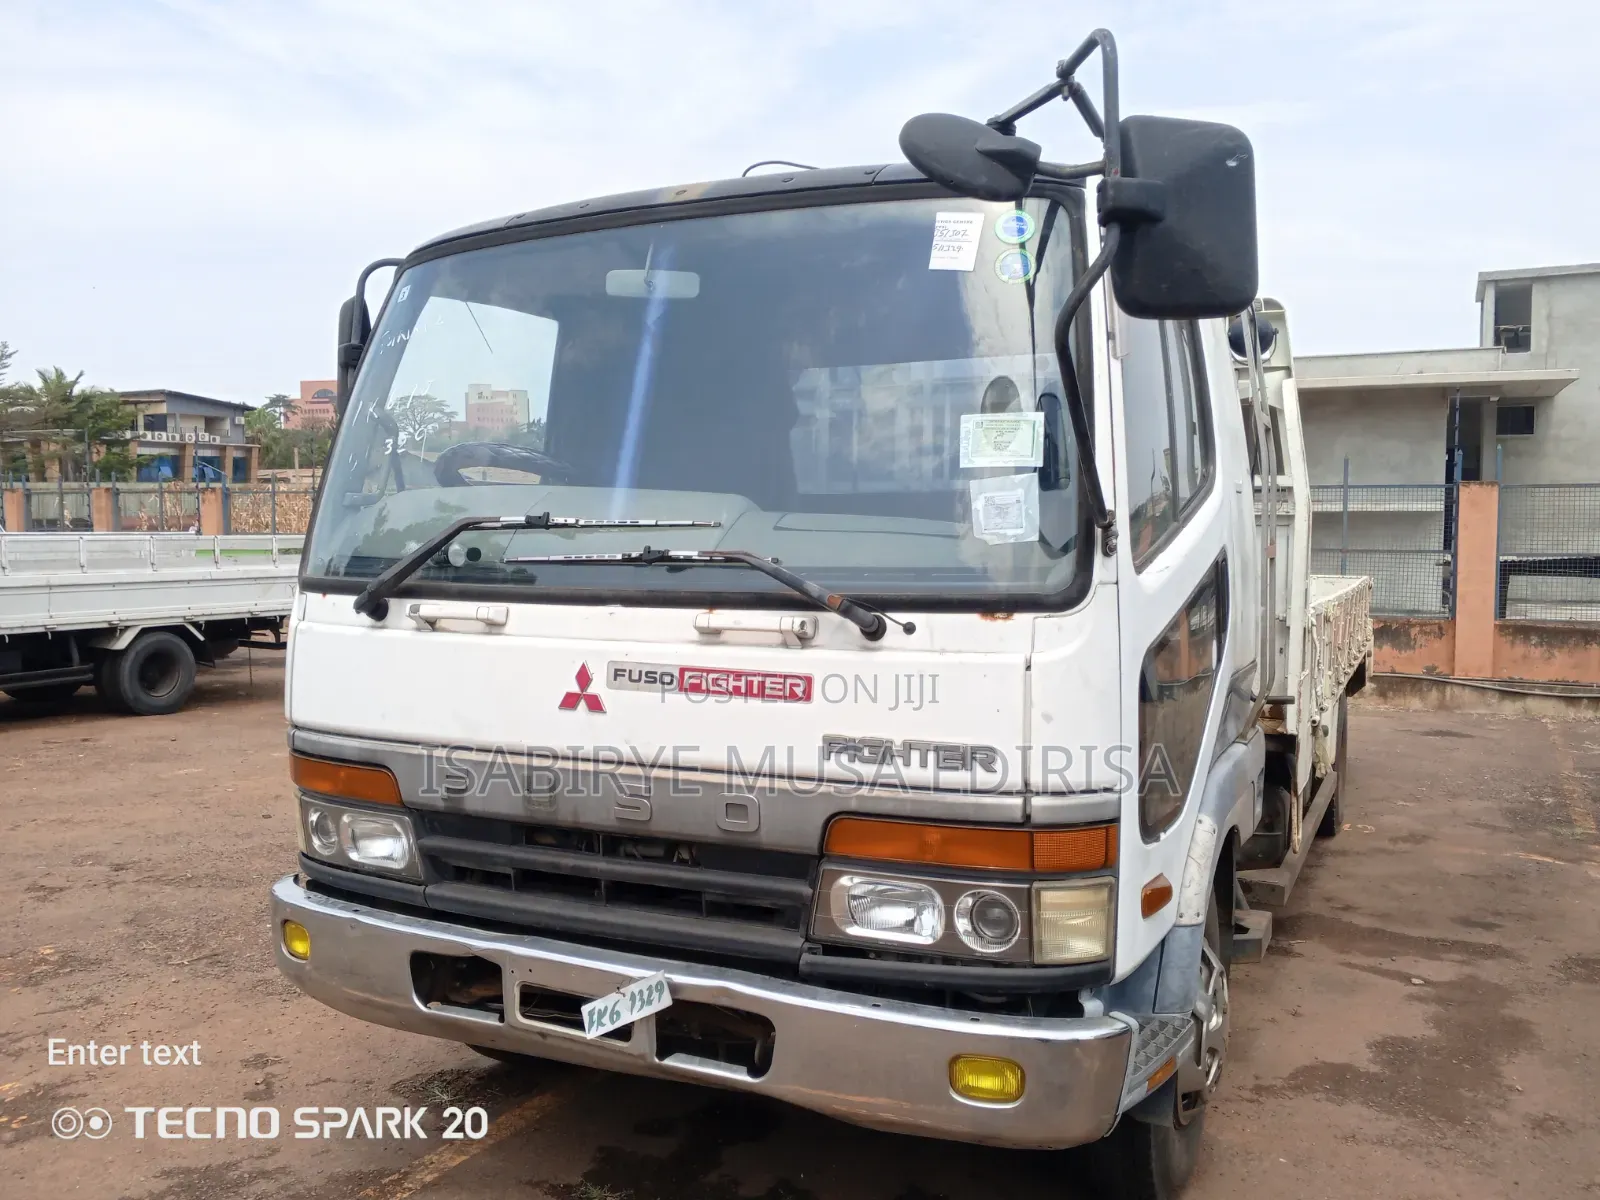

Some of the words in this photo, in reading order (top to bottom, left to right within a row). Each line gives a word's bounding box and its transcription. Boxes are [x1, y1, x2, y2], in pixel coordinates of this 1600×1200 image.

[613, 668, 675, 686] FUSO
[683, 671, 805, 699] FIGHTER
[822, 734, 997, 773] FIGHTER
